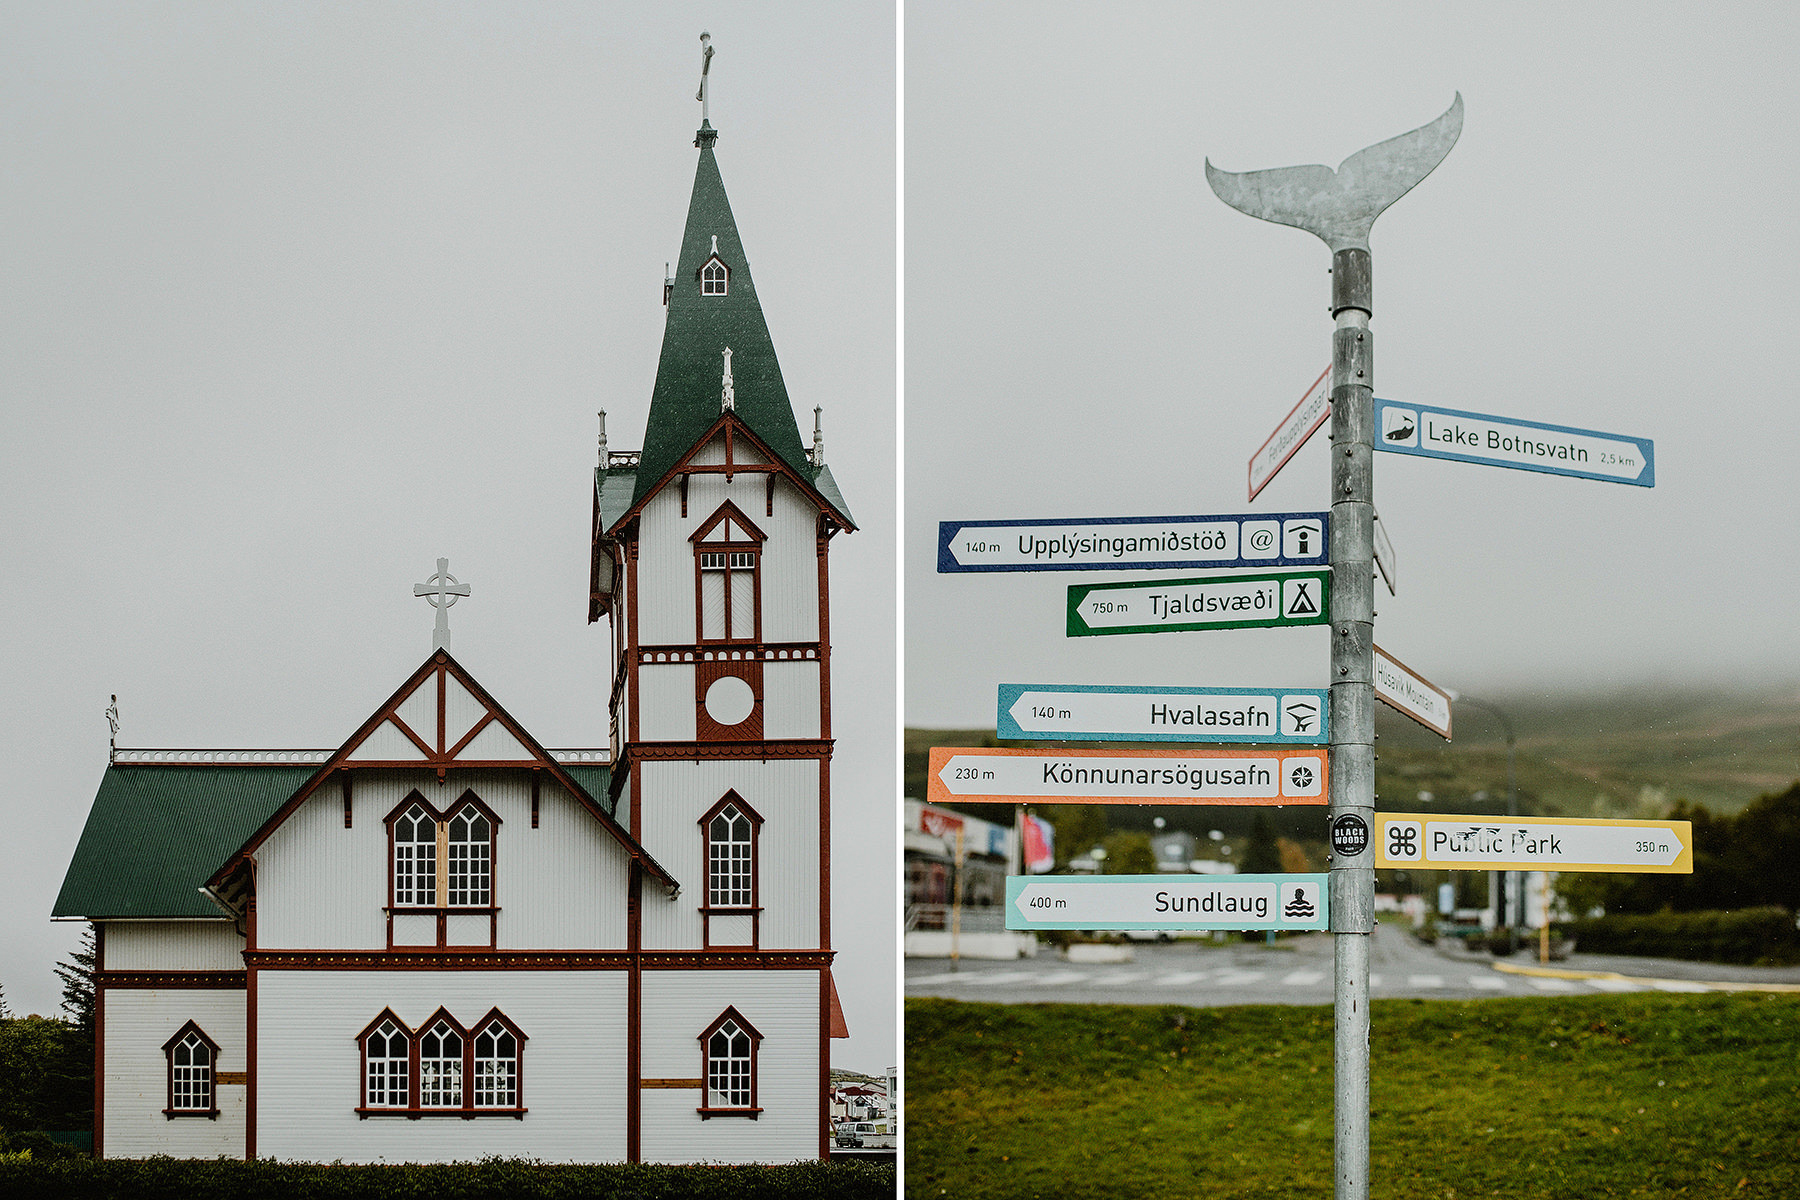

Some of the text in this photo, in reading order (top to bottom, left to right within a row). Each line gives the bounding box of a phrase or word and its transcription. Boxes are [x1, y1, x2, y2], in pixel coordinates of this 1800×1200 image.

[1429, 421, 1635, 467] Lake Botnsvatn 2,5 km
[965, 541, 986, 553] 140
[988, 543, 1001, 553] m
[1018, 530, 1228, 559] Upplýsingamiðstöð
[1092, 589, 1274, 619] 750 m Tjaldsvæði
[1031, 703, 1270, 727] 140 m Hvalasafn
[955, 762, 1271, 789] 230 m Könnunarsögusafn
[1334, 828, 1364, 837] BLACK
[1334, 836, 1365, 845] WOODS
[1433, 829, 1669, 855] Public Park 350 m
[1029, 891, 1268, 918] 400 m Sundlaug
